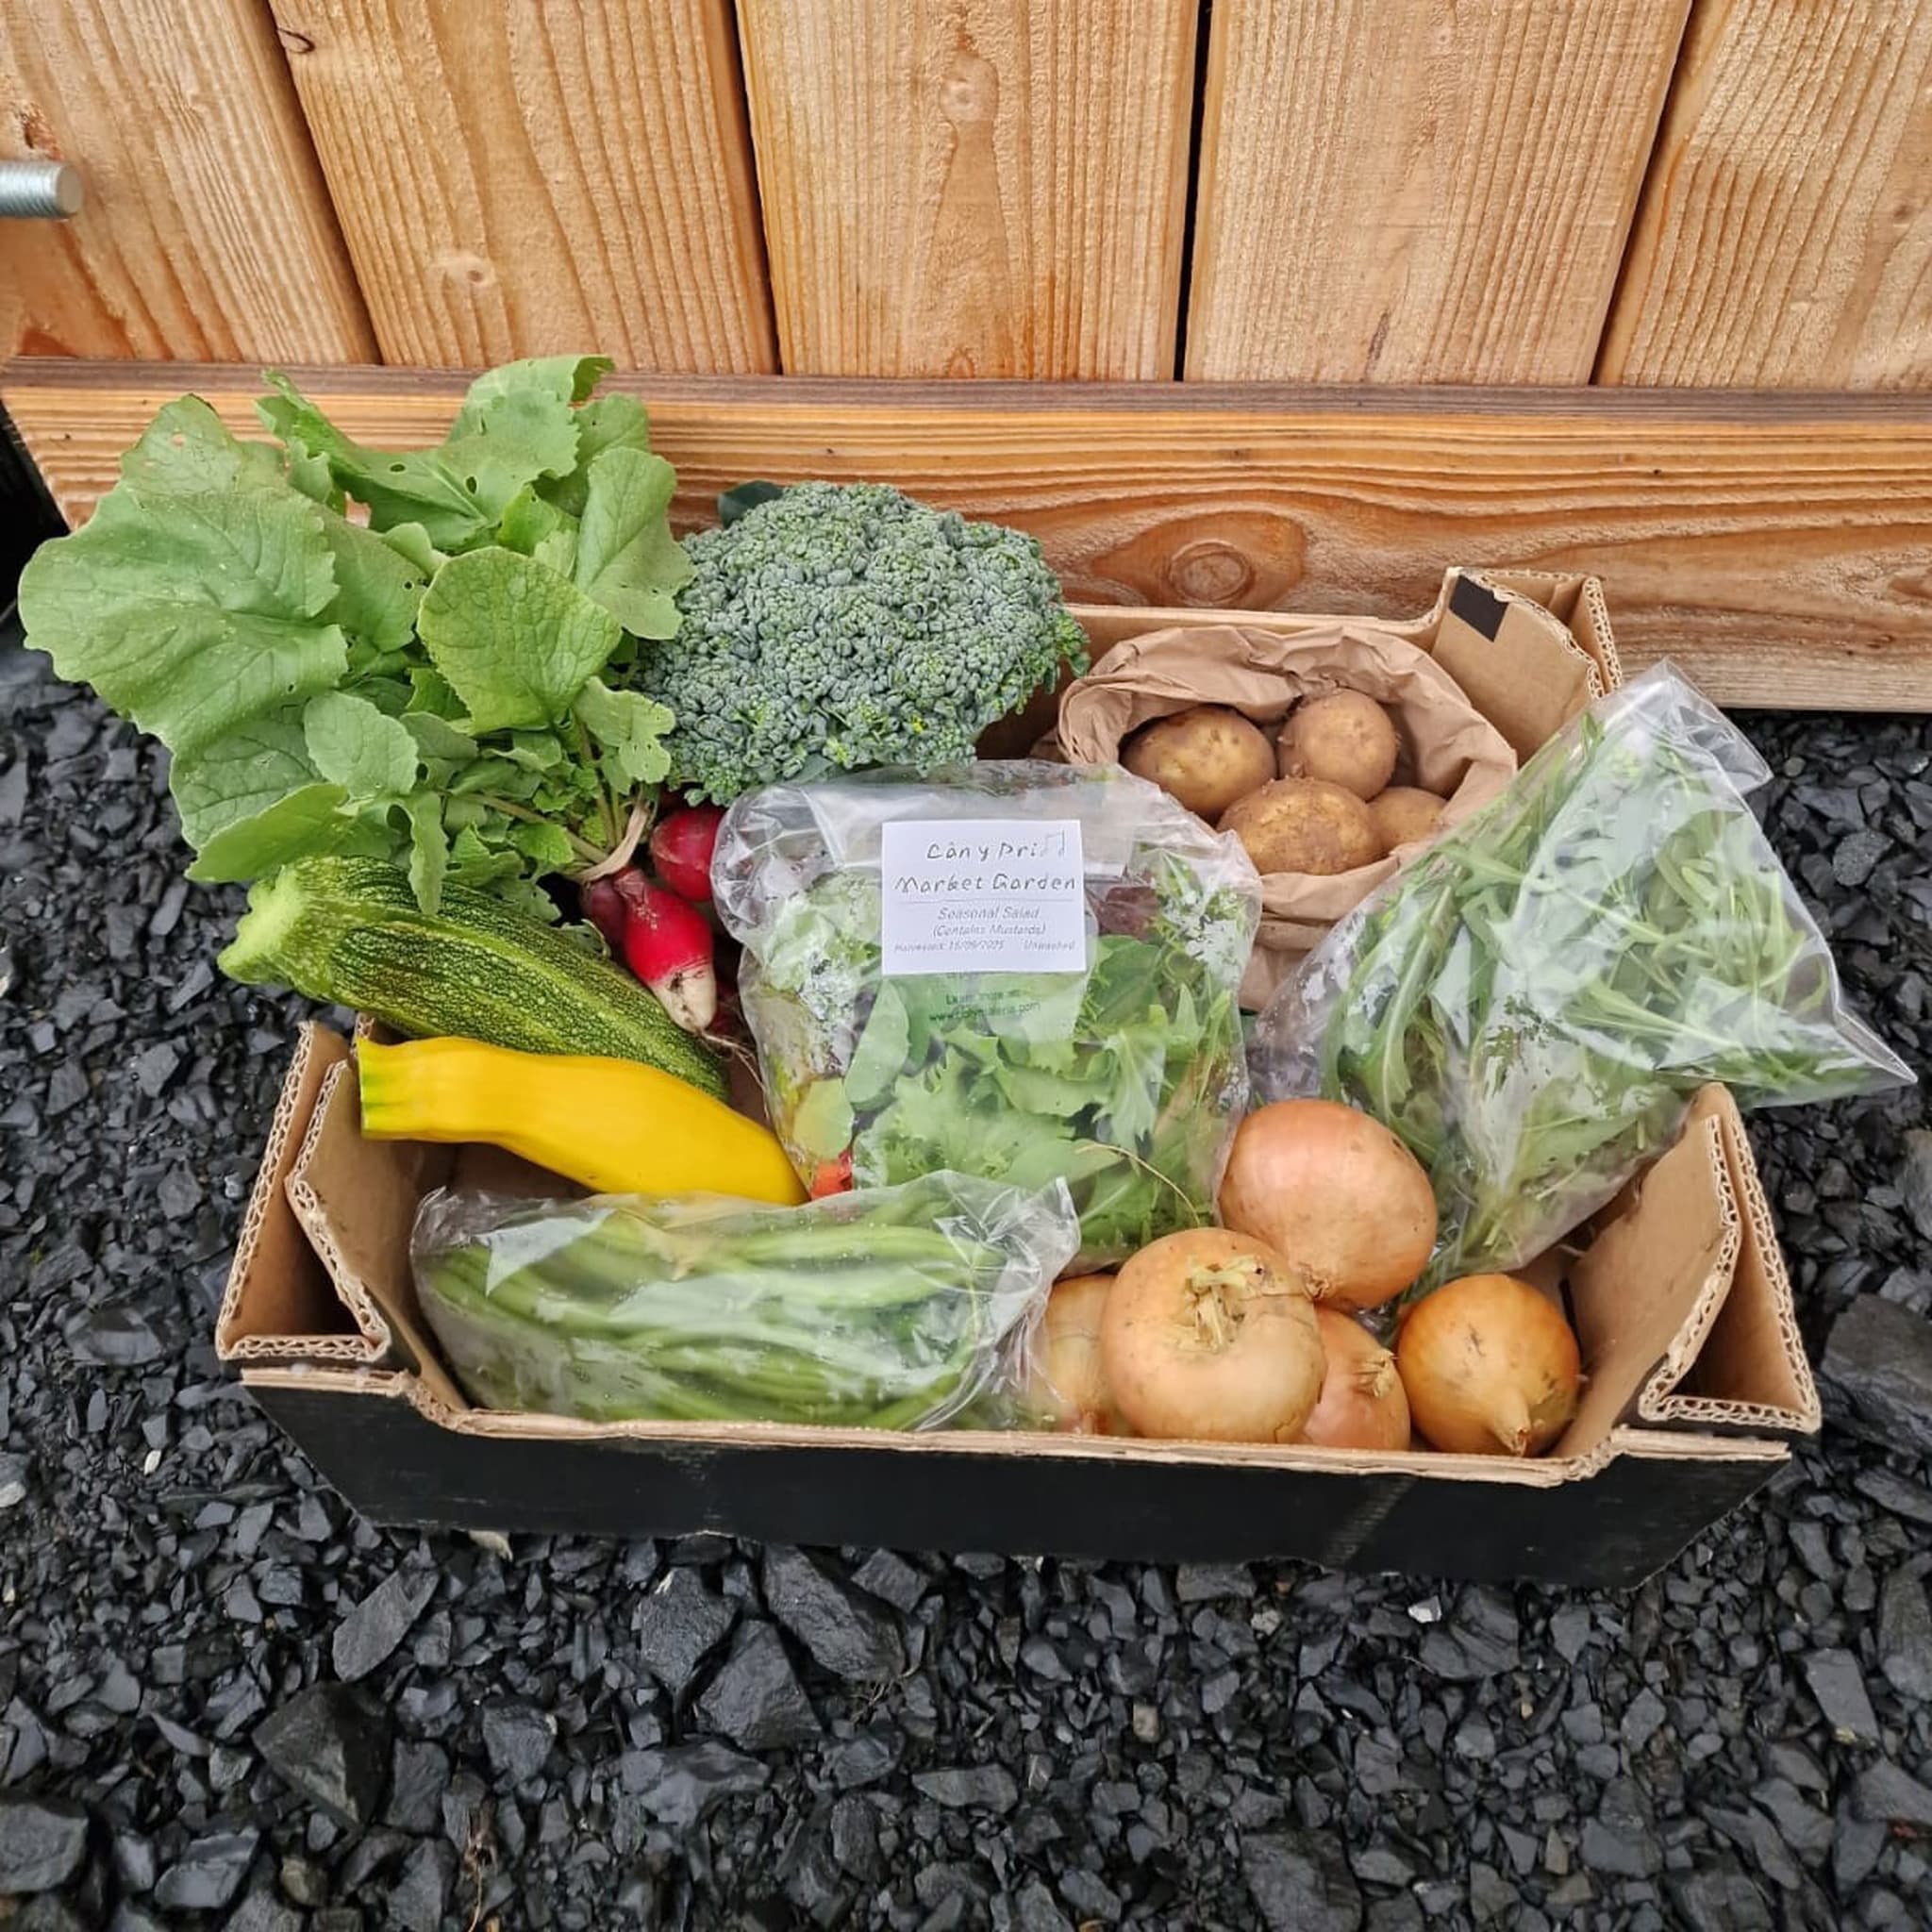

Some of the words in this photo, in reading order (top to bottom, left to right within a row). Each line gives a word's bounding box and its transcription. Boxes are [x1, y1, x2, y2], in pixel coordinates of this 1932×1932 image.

[978, 846, 991, 862] y
[894, 874, 982, 893] Market
[992, 873, 1076, 891] Garden
[938, 907, 999, 921] Seasonal
[1002, 906, 1040, 920] Salad
